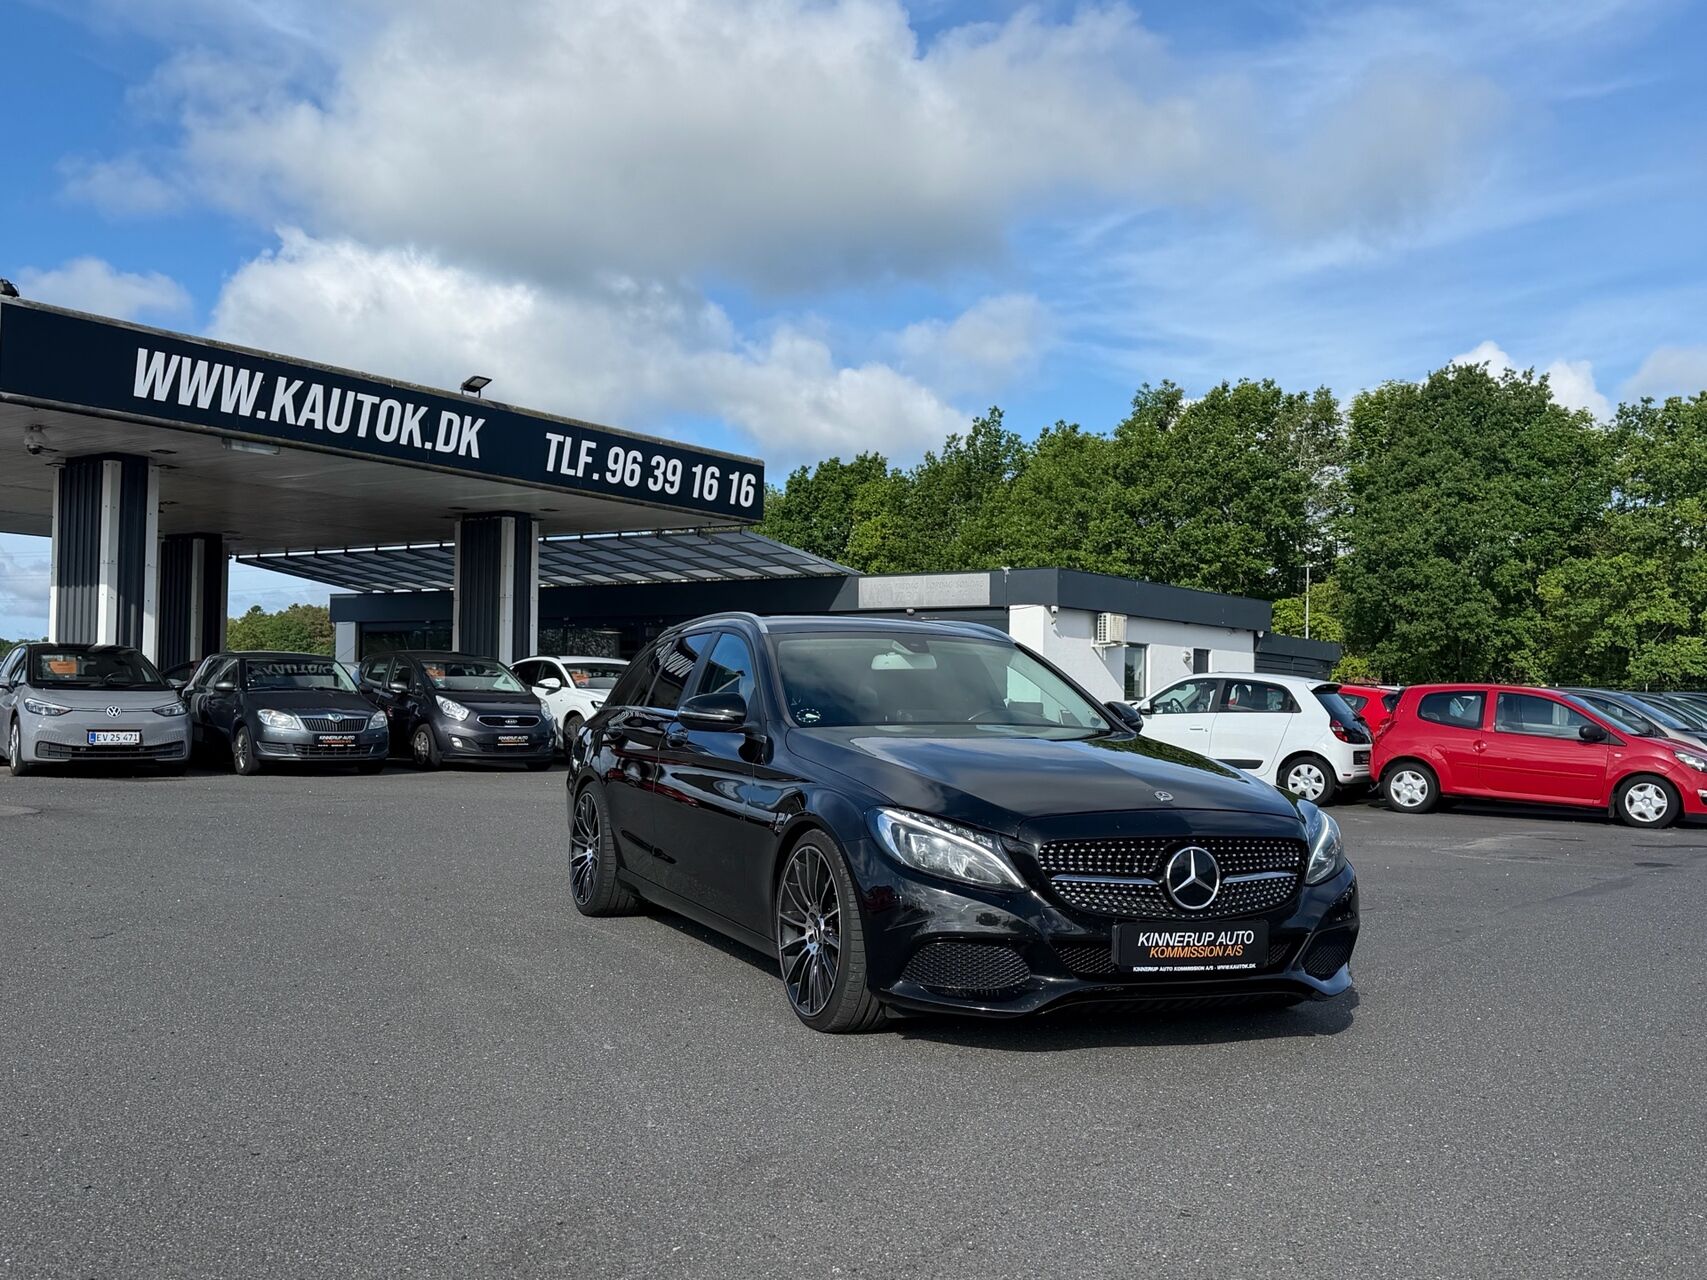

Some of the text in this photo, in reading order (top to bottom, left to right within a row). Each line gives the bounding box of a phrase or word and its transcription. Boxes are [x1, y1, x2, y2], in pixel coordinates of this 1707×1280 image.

[133, 347, 485, 459] WWW.KAUTOK.DK
[545, 432, 757, 508] TLF. 96 39 16 16
[97, 733, 138, 742] EV 25 471
[1137, 930, 1255, 947] KINNERUP AUTO
[1149, 945, 1244, 959] KOMMISSION A/S
